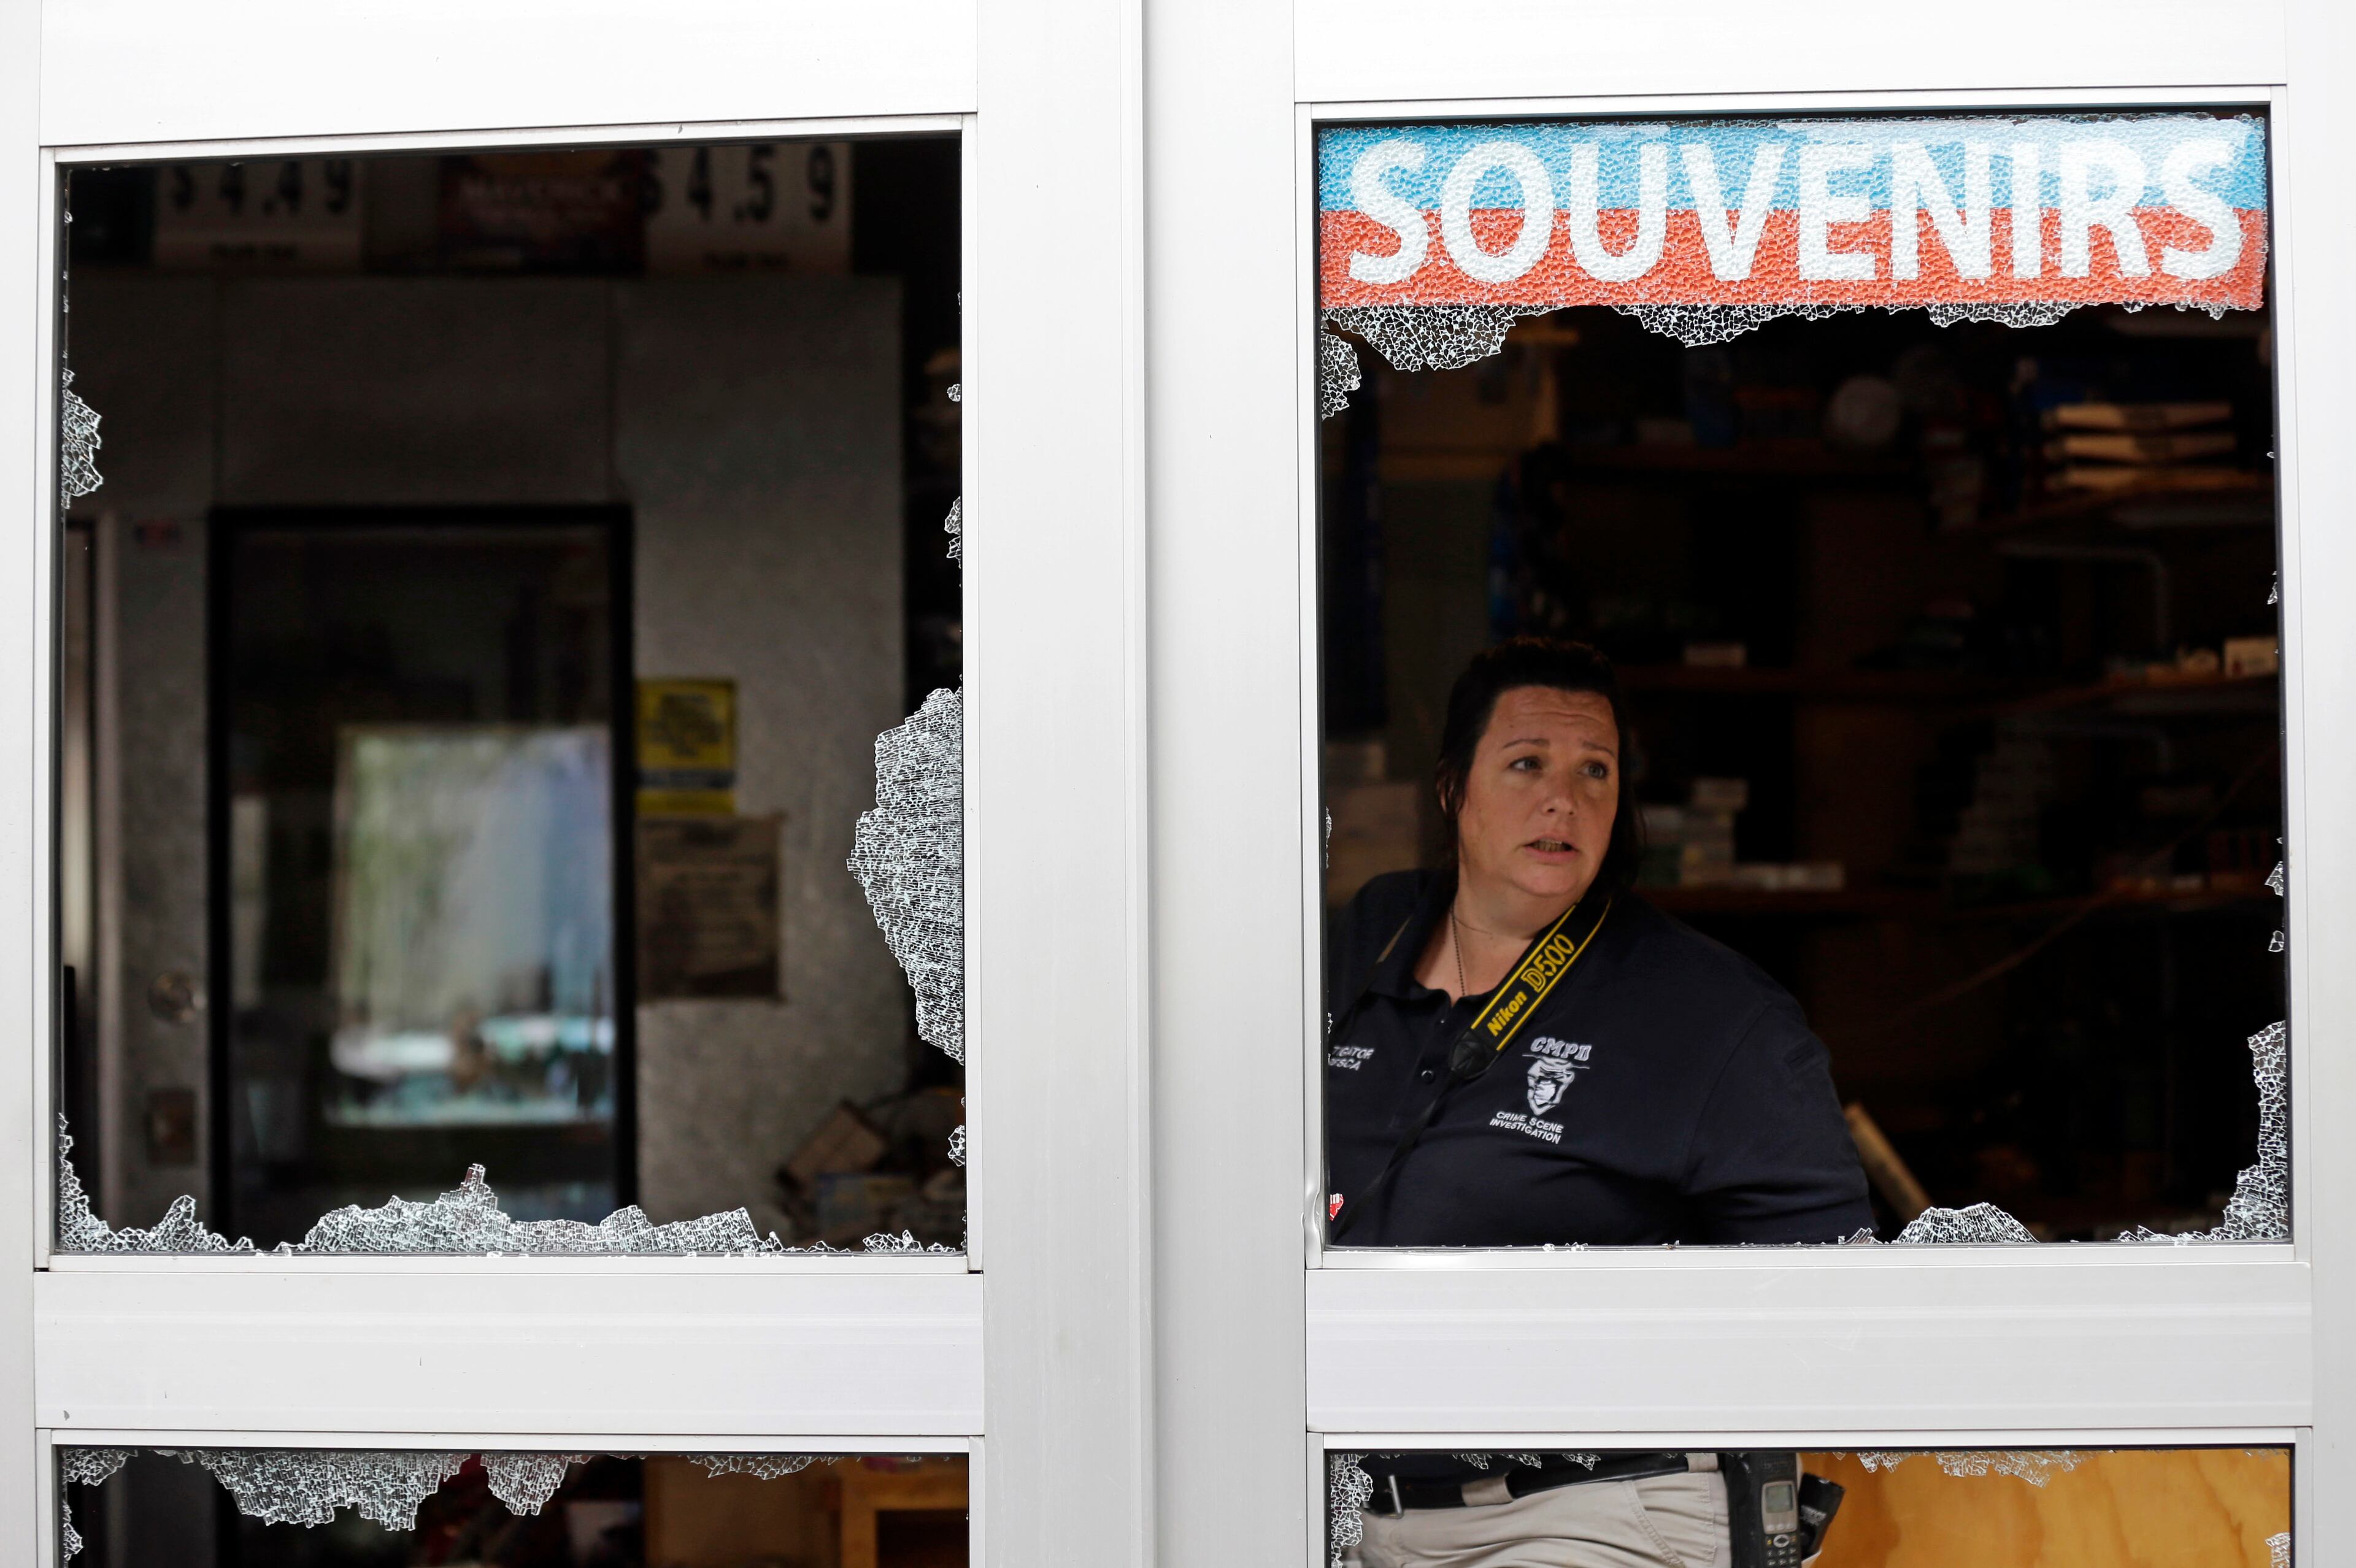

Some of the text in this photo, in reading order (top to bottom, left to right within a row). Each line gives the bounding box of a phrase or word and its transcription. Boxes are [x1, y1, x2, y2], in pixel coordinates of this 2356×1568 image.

[1349, 139, 2241, 284] SOUVENIRS
[1487, 934, 1574, 1037] Nikon D500
[1490, 1118, 1561, 1145] INVESTIGATION
[1496, 1111, 1564, 1133] CRIME SCENE
